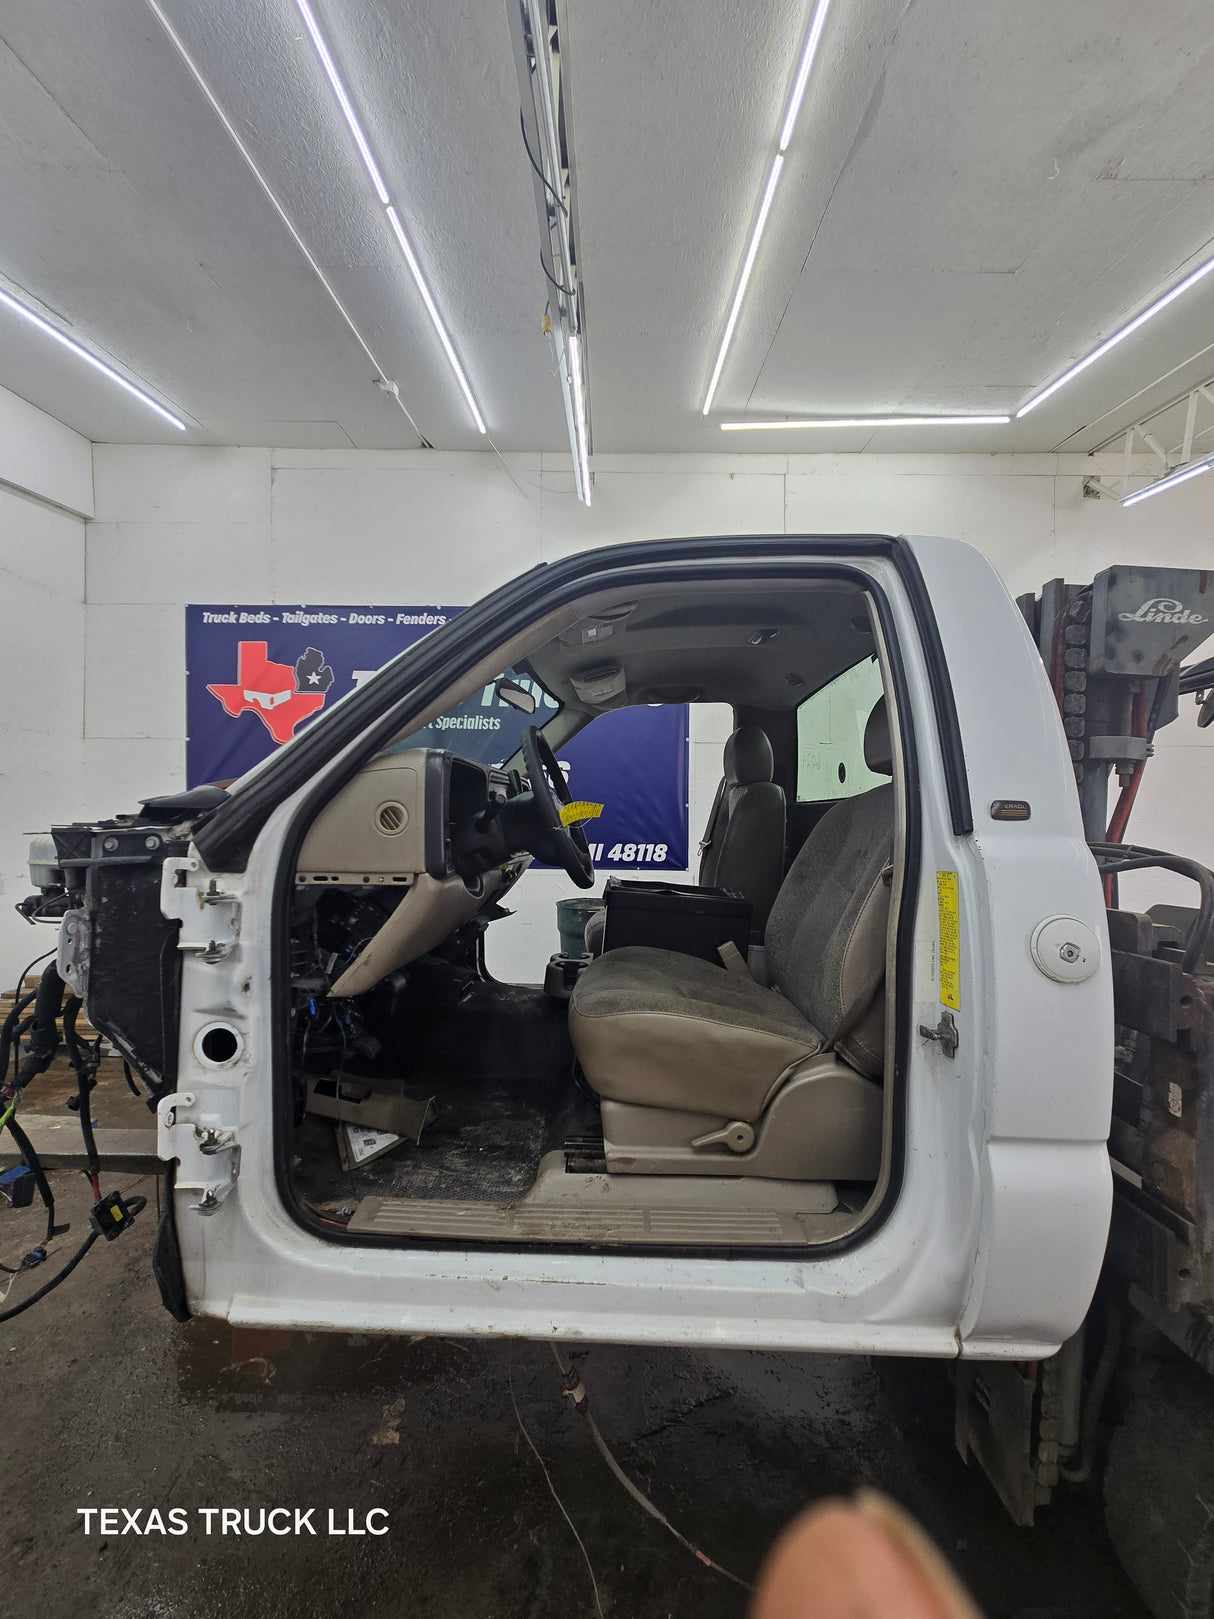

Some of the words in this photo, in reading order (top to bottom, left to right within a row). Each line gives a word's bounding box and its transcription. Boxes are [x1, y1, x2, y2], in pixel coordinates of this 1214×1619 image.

[202, 611, 238, 624] Truck
[239, 611, 271, 624] Beds
[282, 610, 339, 627] Tailgates
[348, 612, 386, 625] Doors
[395, 612, 447, 625] Fenders
[1117, 597, 1209, 624] Linde
[435, 714, 501, 731] Specialists
[607, 843, 668, 862] 48118
